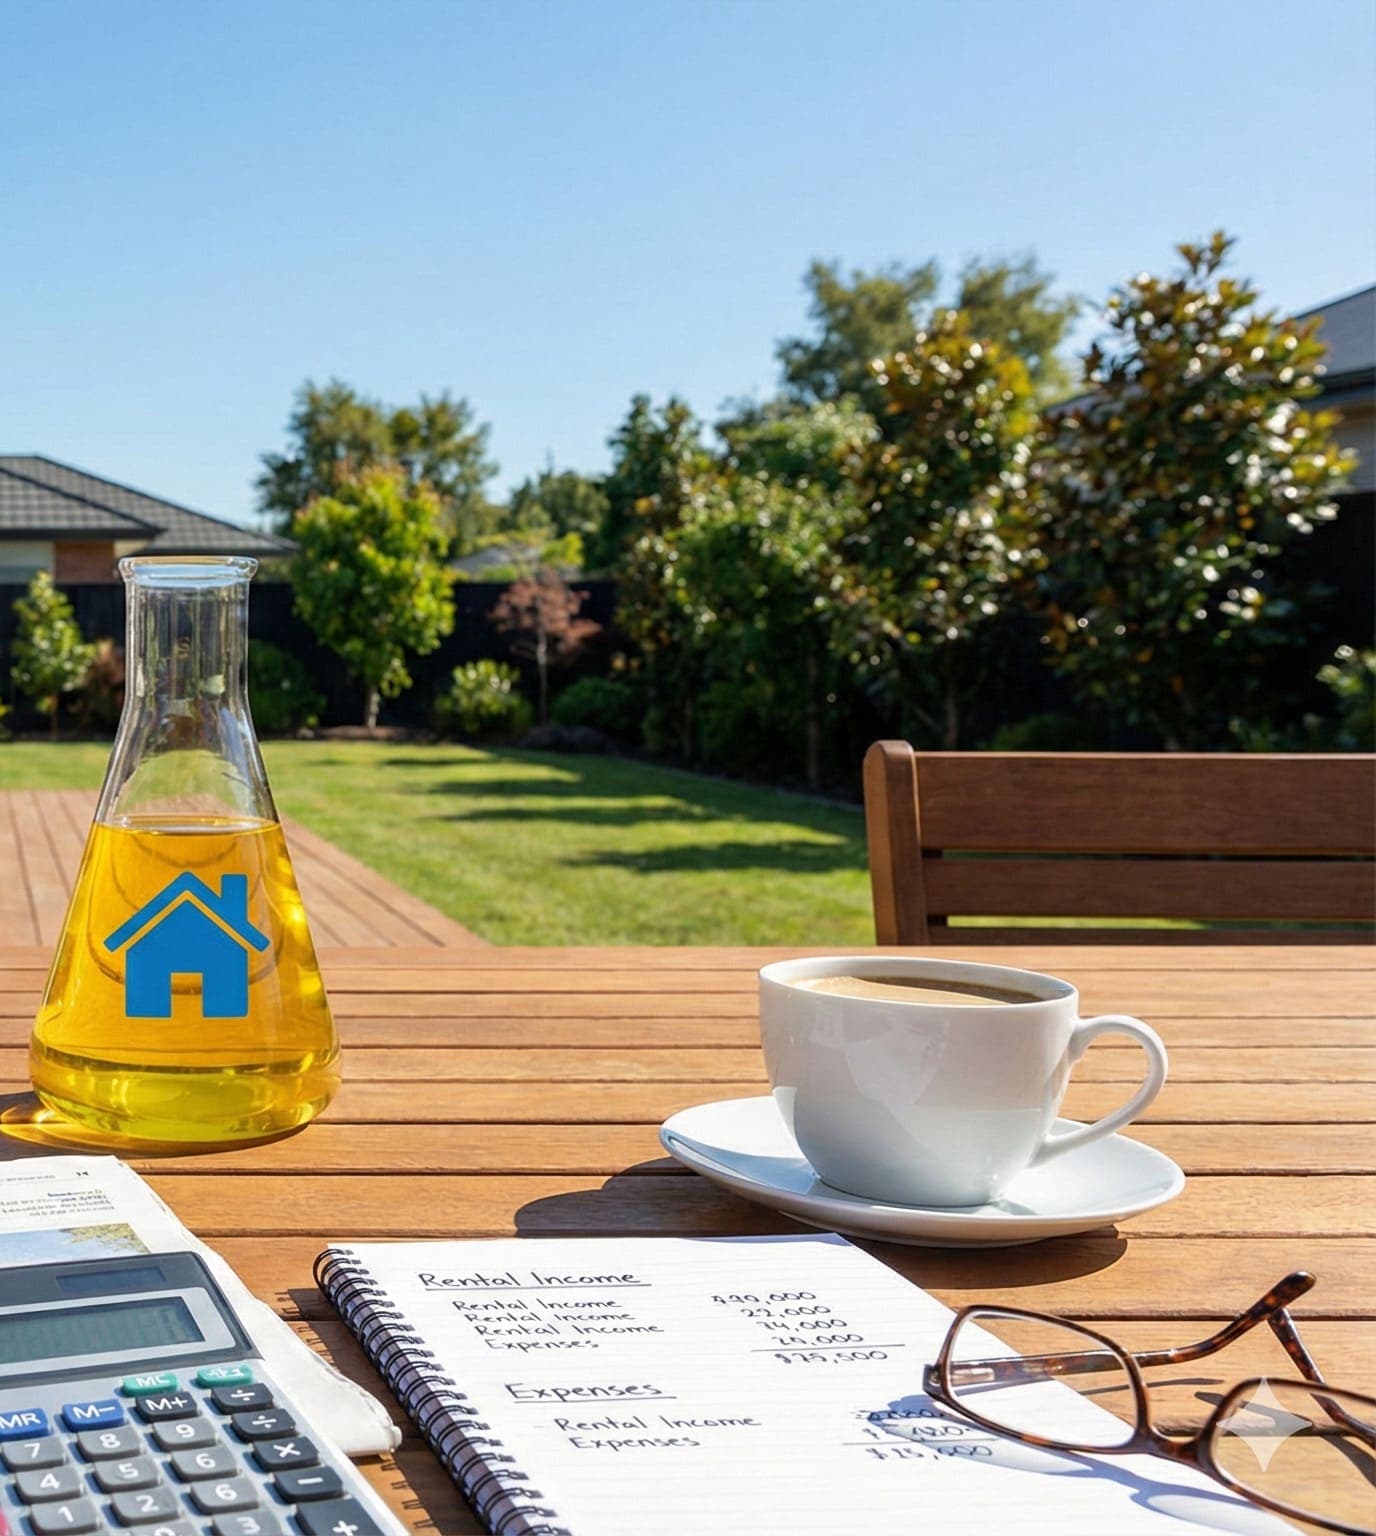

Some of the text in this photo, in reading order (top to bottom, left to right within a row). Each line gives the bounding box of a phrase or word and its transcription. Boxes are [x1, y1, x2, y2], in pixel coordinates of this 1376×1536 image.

[418, 1271, 641, 1287] Rental Income
[452, 1298, 623, 1312] Rental Income
[464, 1312, 637, 1323] Rental Income
[474, 1323, 665, 1337] Rental Income
[484, 1338, 600, 1353] Expenses
[504, 1383, 664, 1402] Expenses
[72, 1405, 116, 1419] M-
[145, 1397, 188, 1412] M+
[554, 1415, 763, 1432] Rental Income
[24, 1442, 41, 1459] 7
[99, 1433, 121, 1449] 8
[175, 1423, 195, 1439] 9
[568, 1436, 701, 1452] Expenses
[39, 1473, 61, 1490] 4
[125, 1463, 139, 1478] 5
[195, 1453, 216, 1469] 6
[57, 1485, 238, 1523] 1 2 6
[236, 1516, 261, 1535] 3
